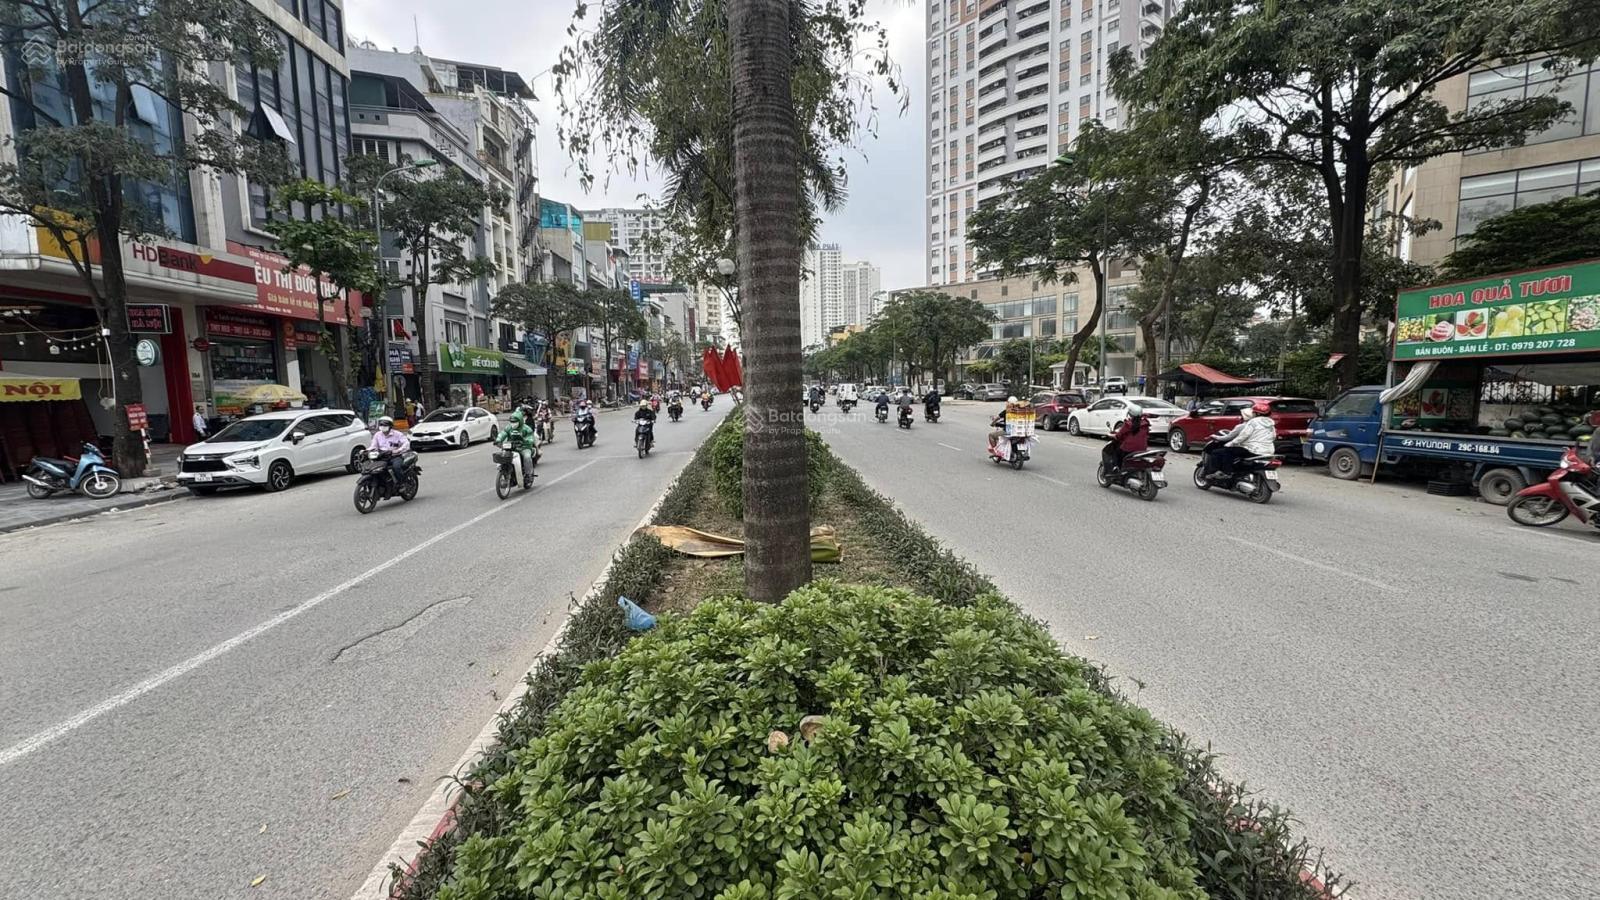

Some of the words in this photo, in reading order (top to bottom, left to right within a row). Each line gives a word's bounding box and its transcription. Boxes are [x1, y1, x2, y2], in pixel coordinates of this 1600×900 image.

[132, 243, 197, 269] HDBank
[295, 273, 317, 295] ĐỨC
[1429, 292, 1465, 309] HOA
[1471, 279, 1512, 304] QUẢ
[1519, 275, 1572, 298] TƯƠI
[1415, 346, 1431, 355] BÁN
[1432, 345, 1453, 355] BUÔN
[1459, 344, 1477, 353] BÁN
[1511, 341, 1534, 350] 0979
[1535, 340, 1555, 349] 207
[1556, 338, 1576, 347] 728
[2, 381, 62, 398] NỘI
[1415, 440, 1451, 450] HYUNDAI
